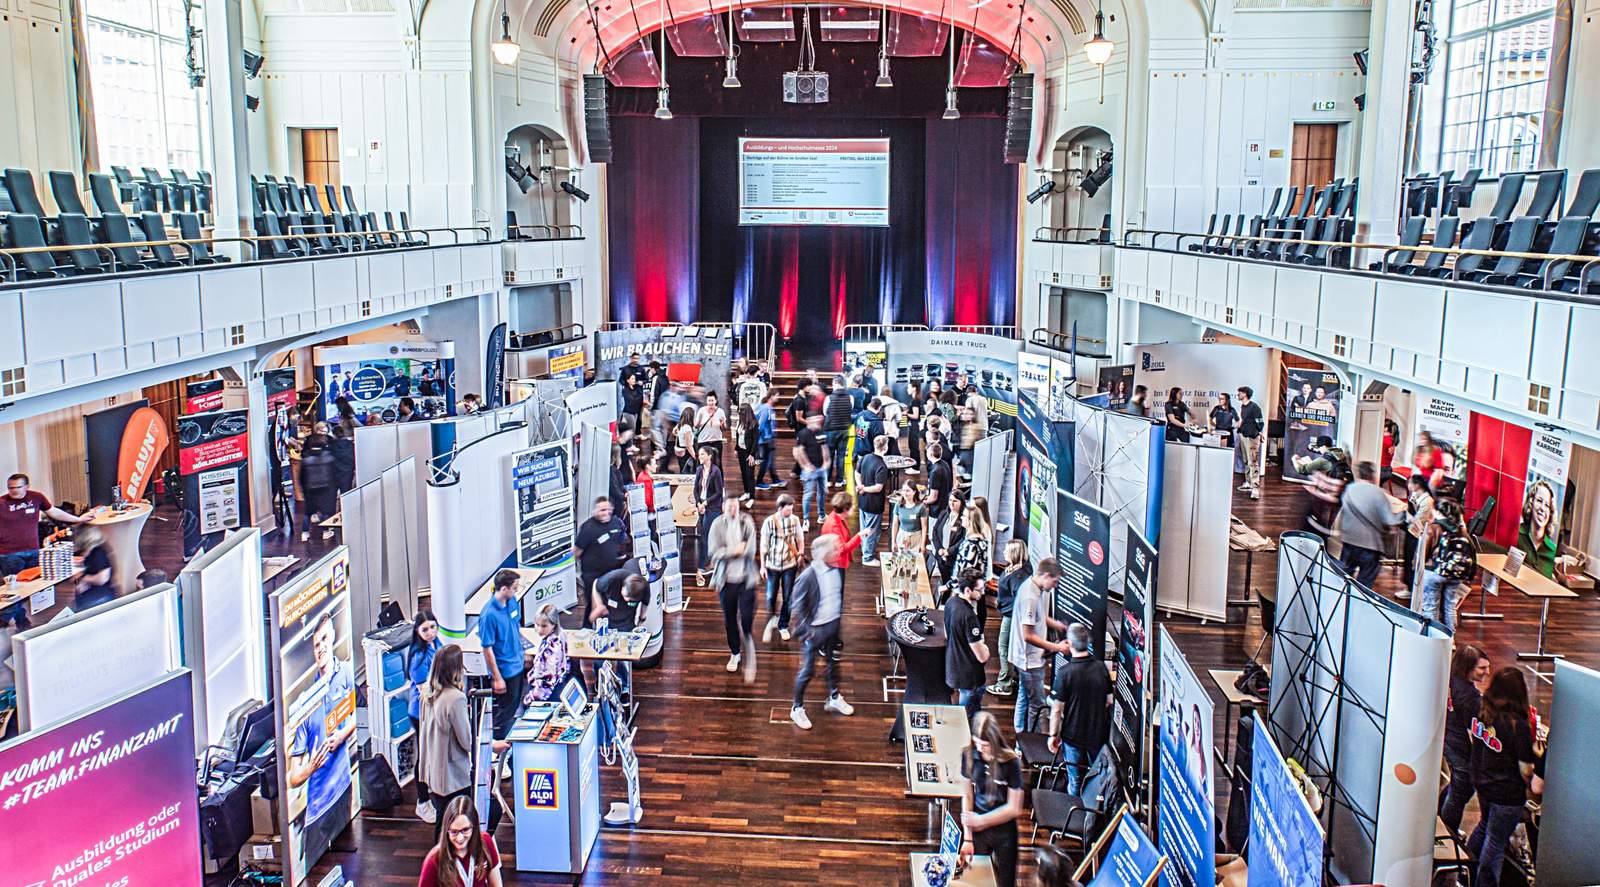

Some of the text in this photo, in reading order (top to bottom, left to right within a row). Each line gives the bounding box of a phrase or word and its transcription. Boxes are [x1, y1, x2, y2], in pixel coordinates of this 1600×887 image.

[600, 342, 728, 360] WIR BRAUCHEN SIE!
[1424, 408, 1462, 420] EINDRUCK.
[1430, 404, 1455, 413] MACHT
[1536, 441, 1564, 457] KARRIERE.
[1542, 435, 1562, 447] MACHT
[126, 419, 156, 500] BRAUN
[518, 460, 554, 476] WIR SUCHEN
[518, 471, 557, 486] NEUE AZUBIS!
[543, 581, 563, 597] X2E
[0, 730, 104, 790] KOMM INS
[3, 713, 184, 810] #TEAM.FINANZAMT
[530, 792, 553, 800] ALDI
[52, 802, 182, 881] Ausbildung oder
[1254, 800, 1289, 887] WE WANT
[52, 818, 180, 887] Duales Studium
